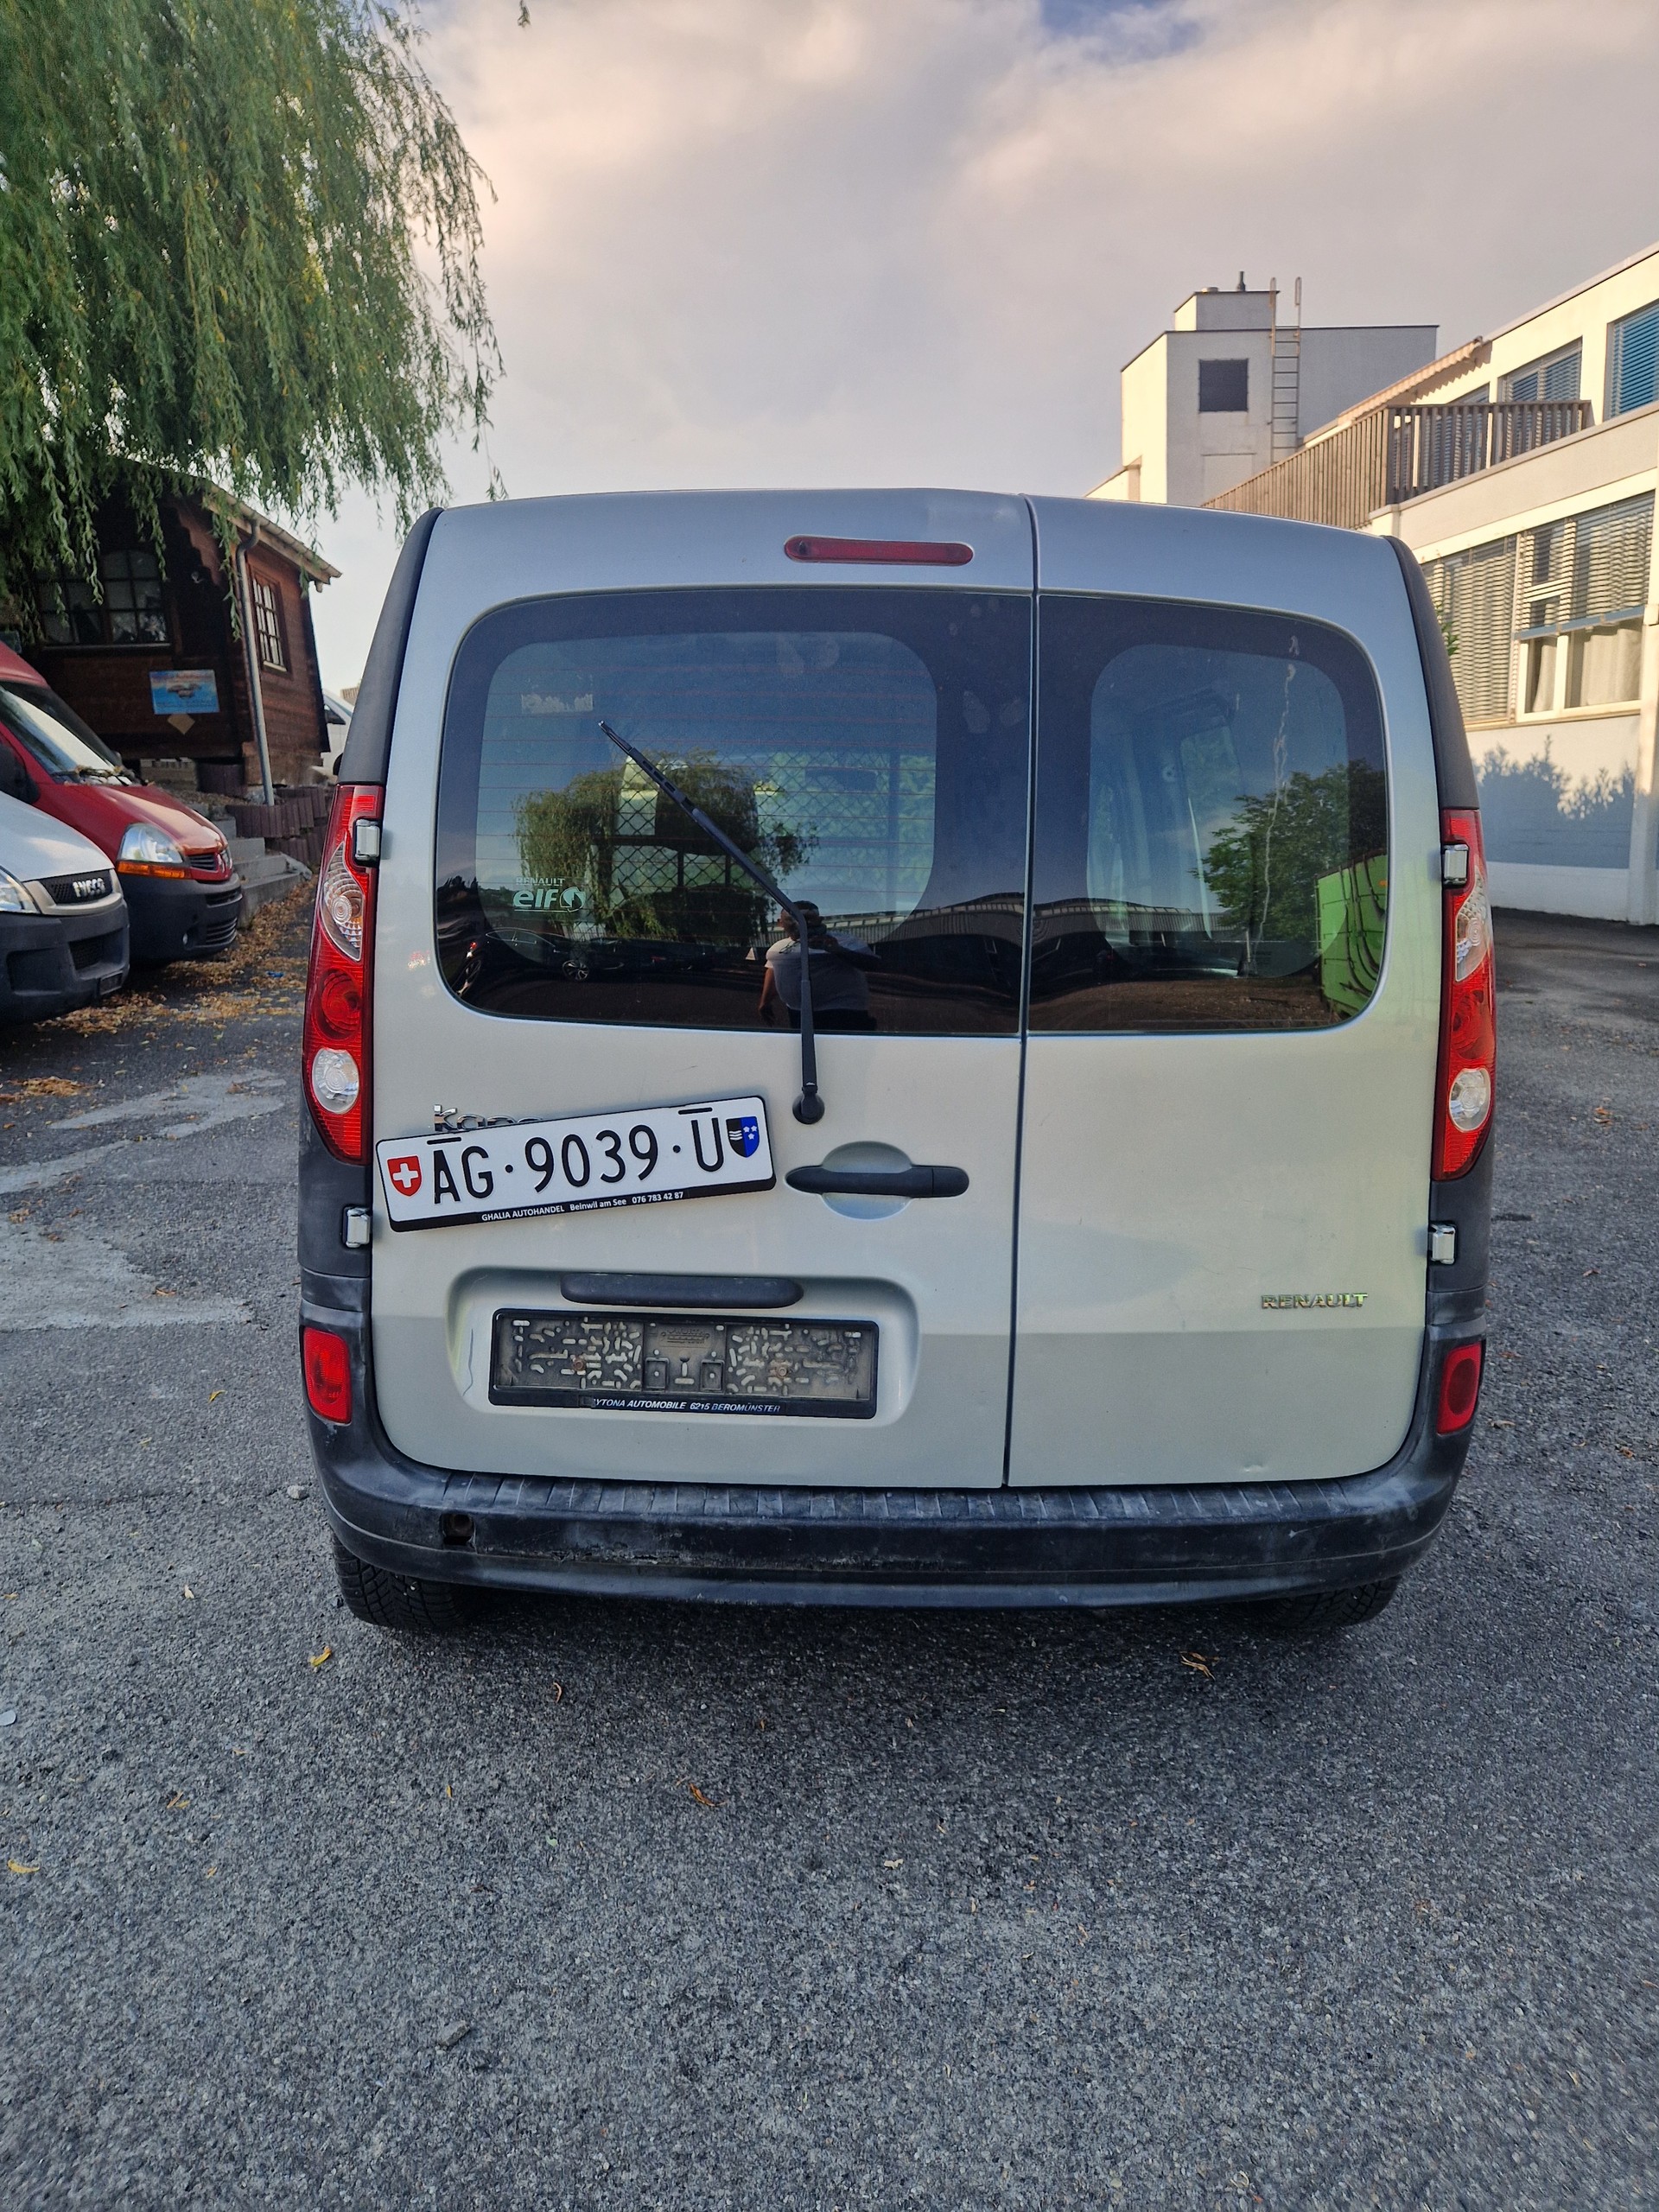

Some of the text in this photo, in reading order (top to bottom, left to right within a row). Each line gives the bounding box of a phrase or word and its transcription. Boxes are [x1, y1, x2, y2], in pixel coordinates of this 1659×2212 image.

[516, 877, 565, 887] RENAULT
[513, 889, 559, 909] elf
[481, 1212, 512, 1222] GHALIA
[512, 1205, 565, 1218] AUTOHANDEL
[569, 1200, 598, 1211] Beinwil
[599, 1199, 612, 1208] am
[632, 1196, 646, 1205] 076
[1262, 1293, 1368, 1309] RENAULT
[626, 1400, 687, 1410] AUTOMOBILE
[690, 1402, 711, 1410] 6215
